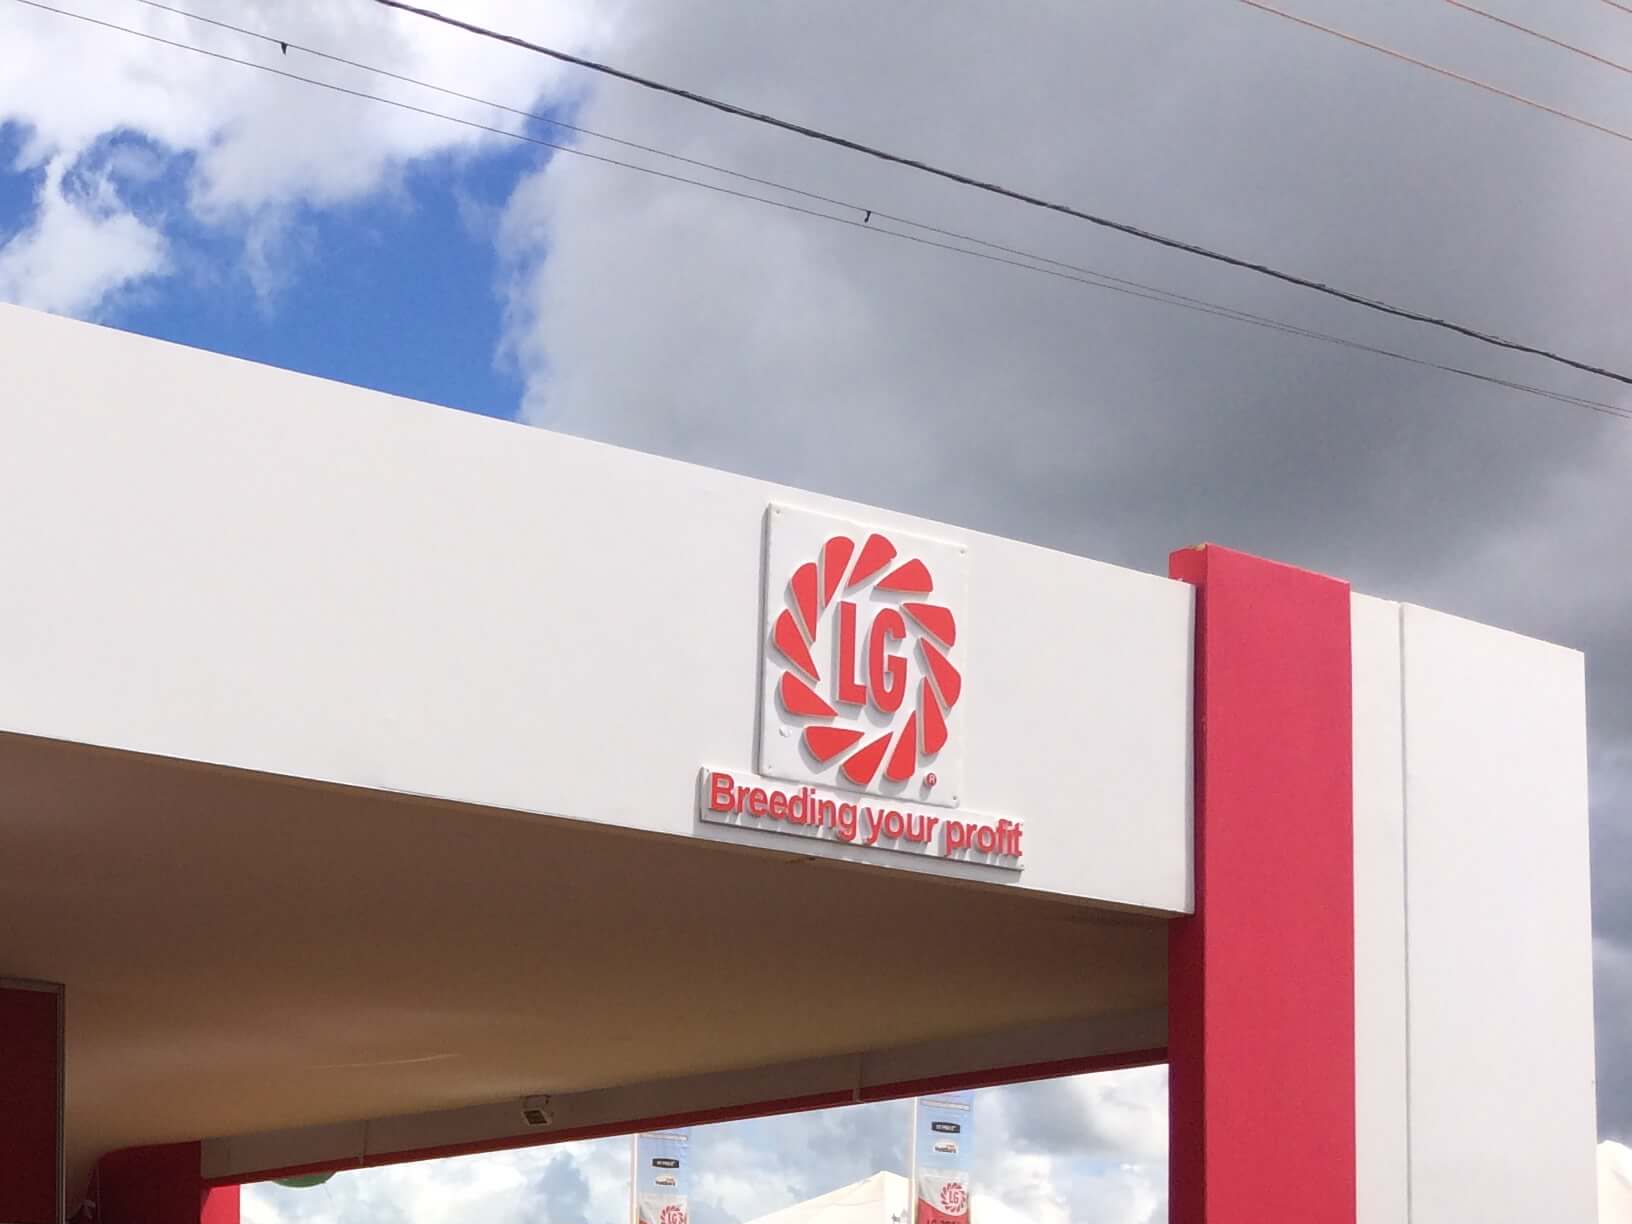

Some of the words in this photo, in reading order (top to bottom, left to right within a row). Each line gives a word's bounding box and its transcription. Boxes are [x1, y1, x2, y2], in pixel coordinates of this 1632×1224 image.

[836, 600, 908, 713] LG
[708, 771, 858, 843] Breeding
[867, 808, 939, 847] your
[944, 818, 1024, 859] profit
